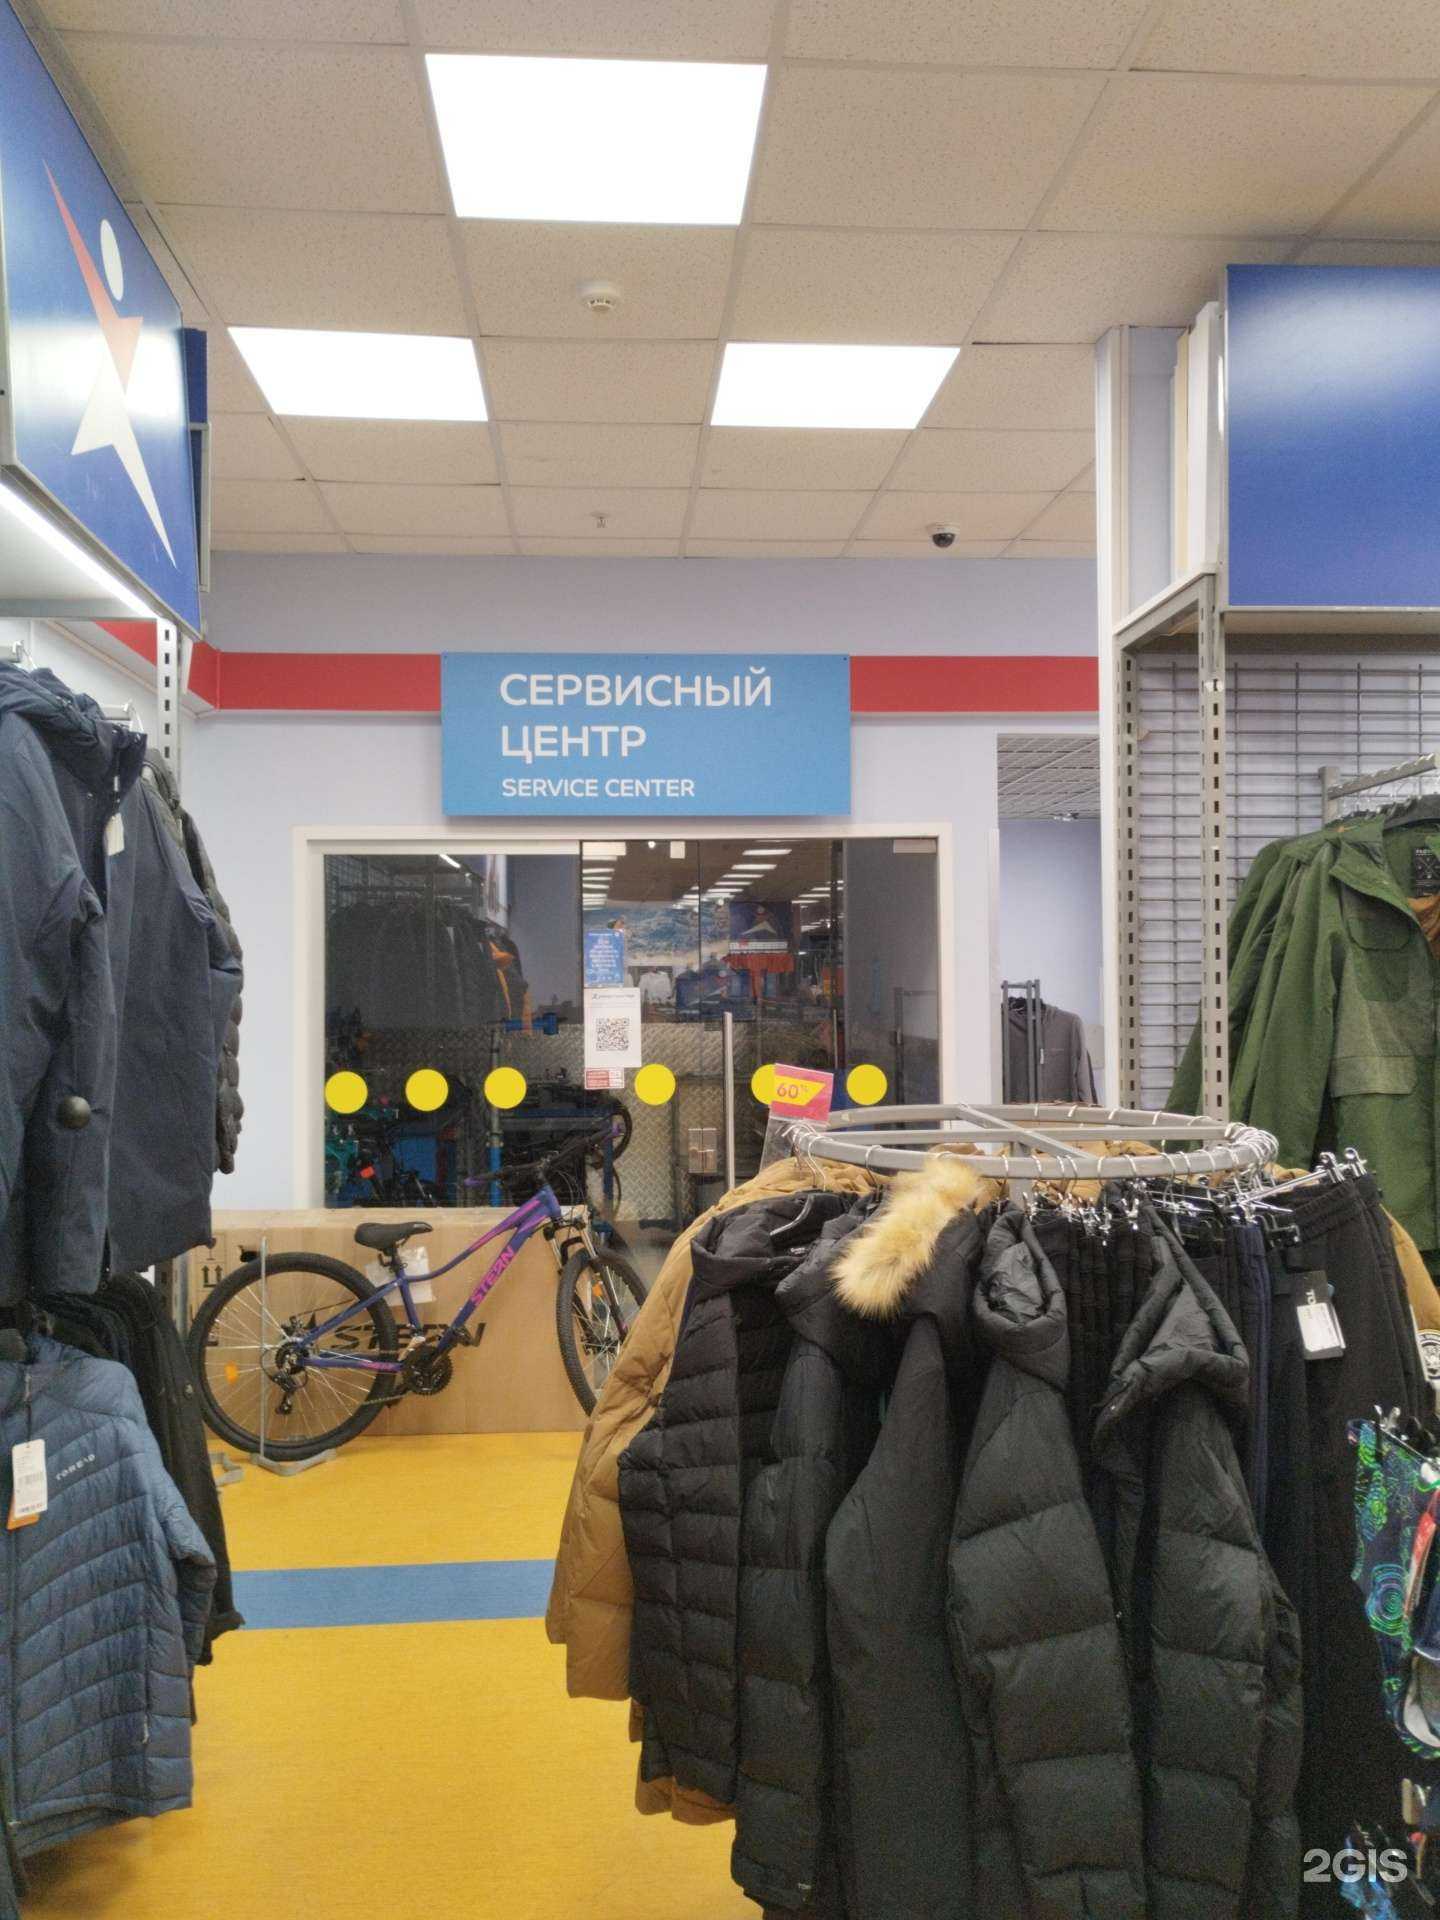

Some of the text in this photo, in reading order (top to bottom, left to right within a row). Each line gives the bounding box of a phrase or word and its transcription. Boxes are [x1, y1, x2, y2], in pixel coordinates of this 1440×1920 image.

[499, 666, 772, 707] СЕРВИСНЫЙ
[501, 725, 647, 765] ЦЕНТР
[501, 778, 695, 798] SERVICE CENTER
[471, 1245, 515, 1306] STERN
